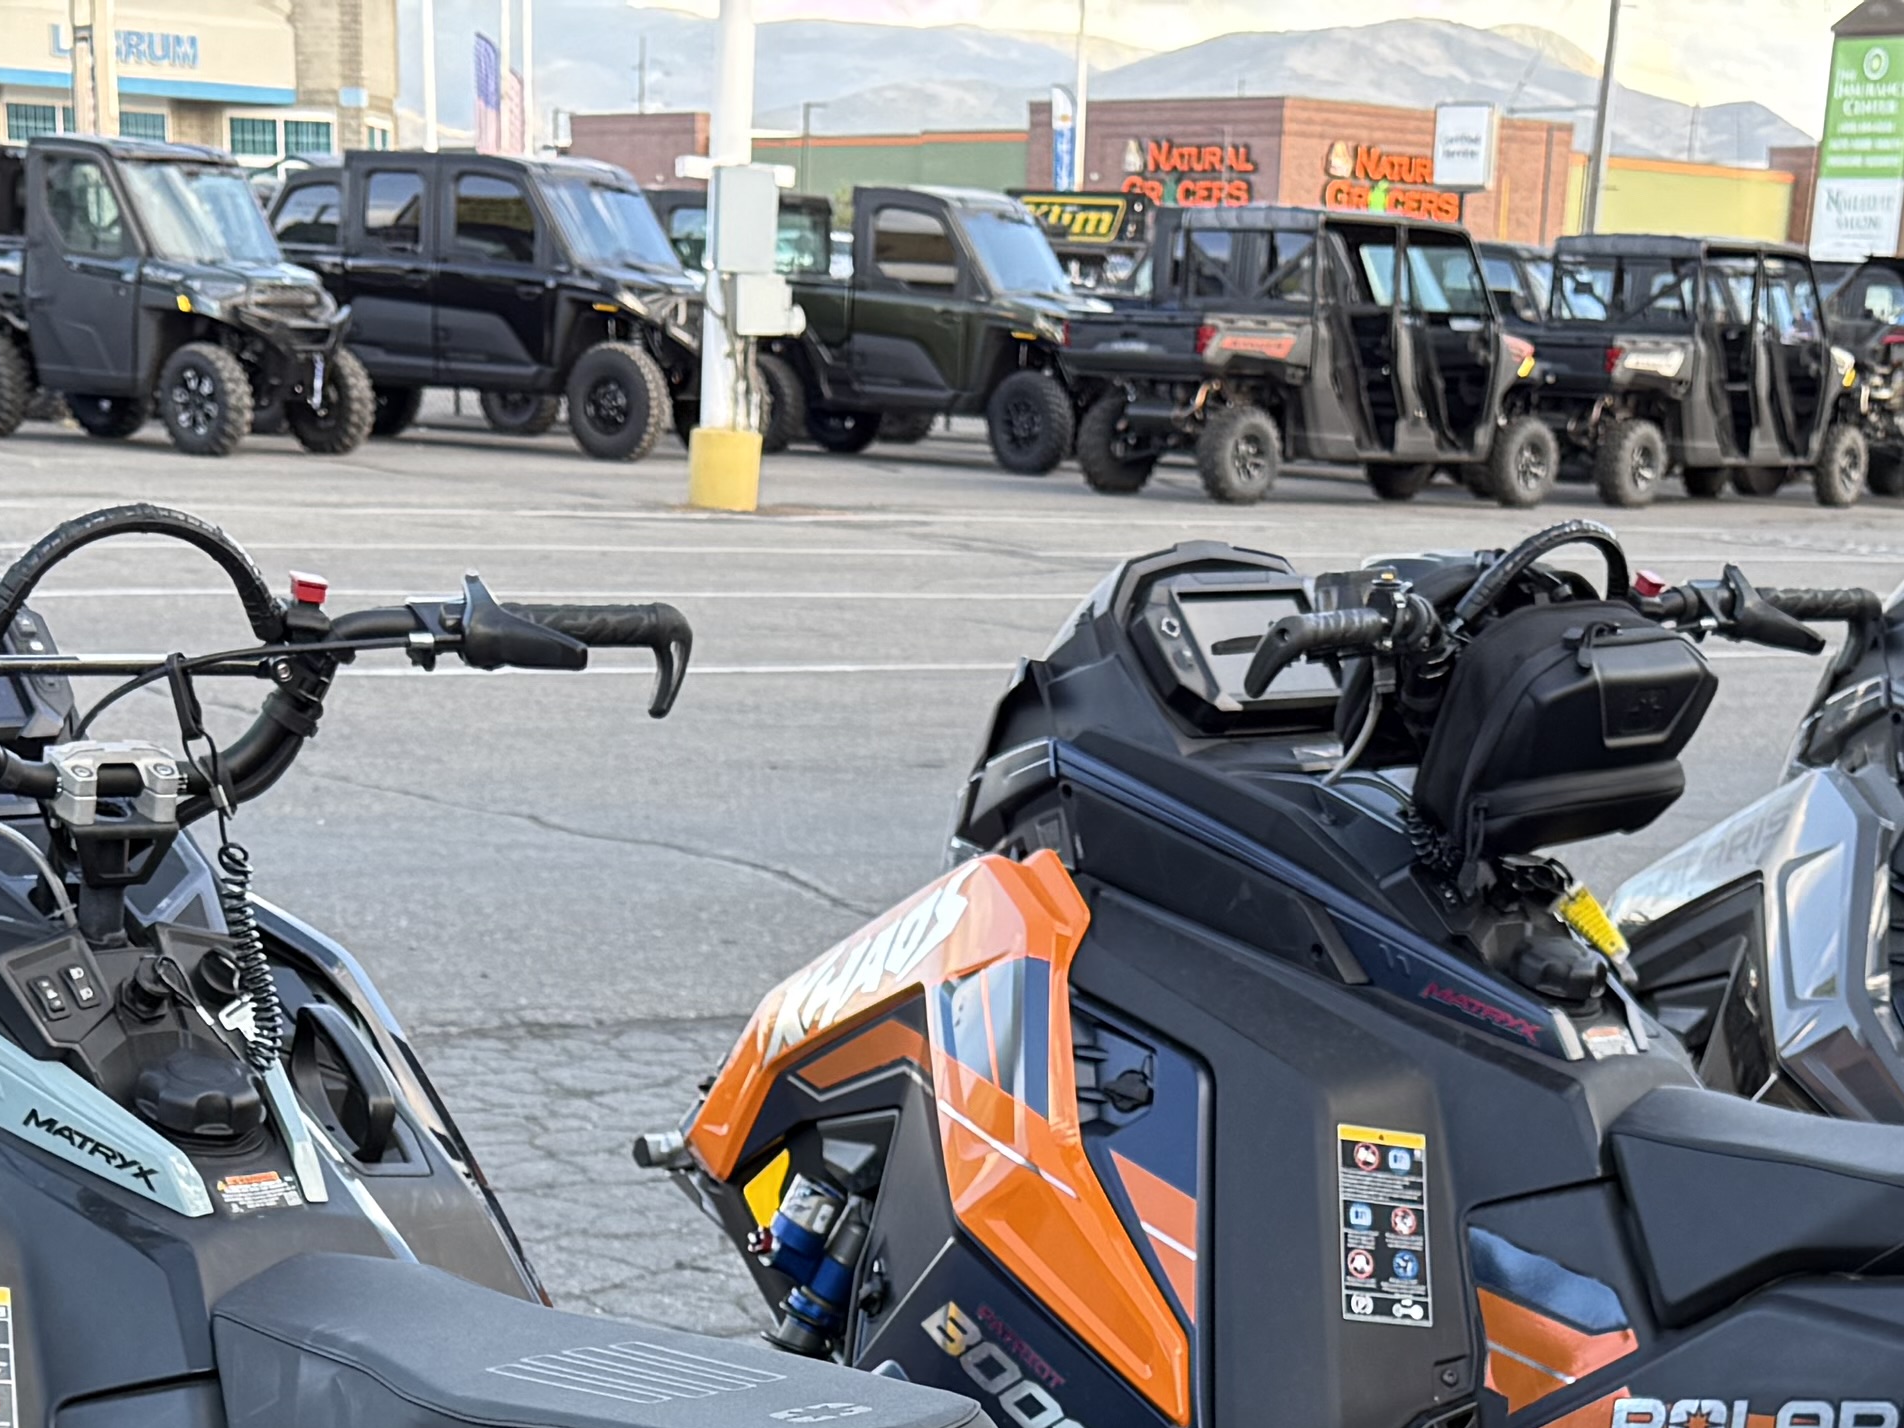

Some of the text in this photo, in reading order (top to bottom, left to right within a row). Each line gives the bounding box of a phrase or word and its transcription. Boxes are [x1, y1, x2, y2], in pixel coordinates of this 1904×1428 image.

[51, 24, 198, 67] LRUM
[1147, 139, 1255, 172] NATURAL
[1356, 145, 1434, 184] NATUR
[762, 863, 978, 1067] KHAOS
[1421, 982, 1542, 1044] MATRYX
[22, 1107, 160, 1194] MATRYX
[975, 1305, 1067, 1389] PATRIOT
